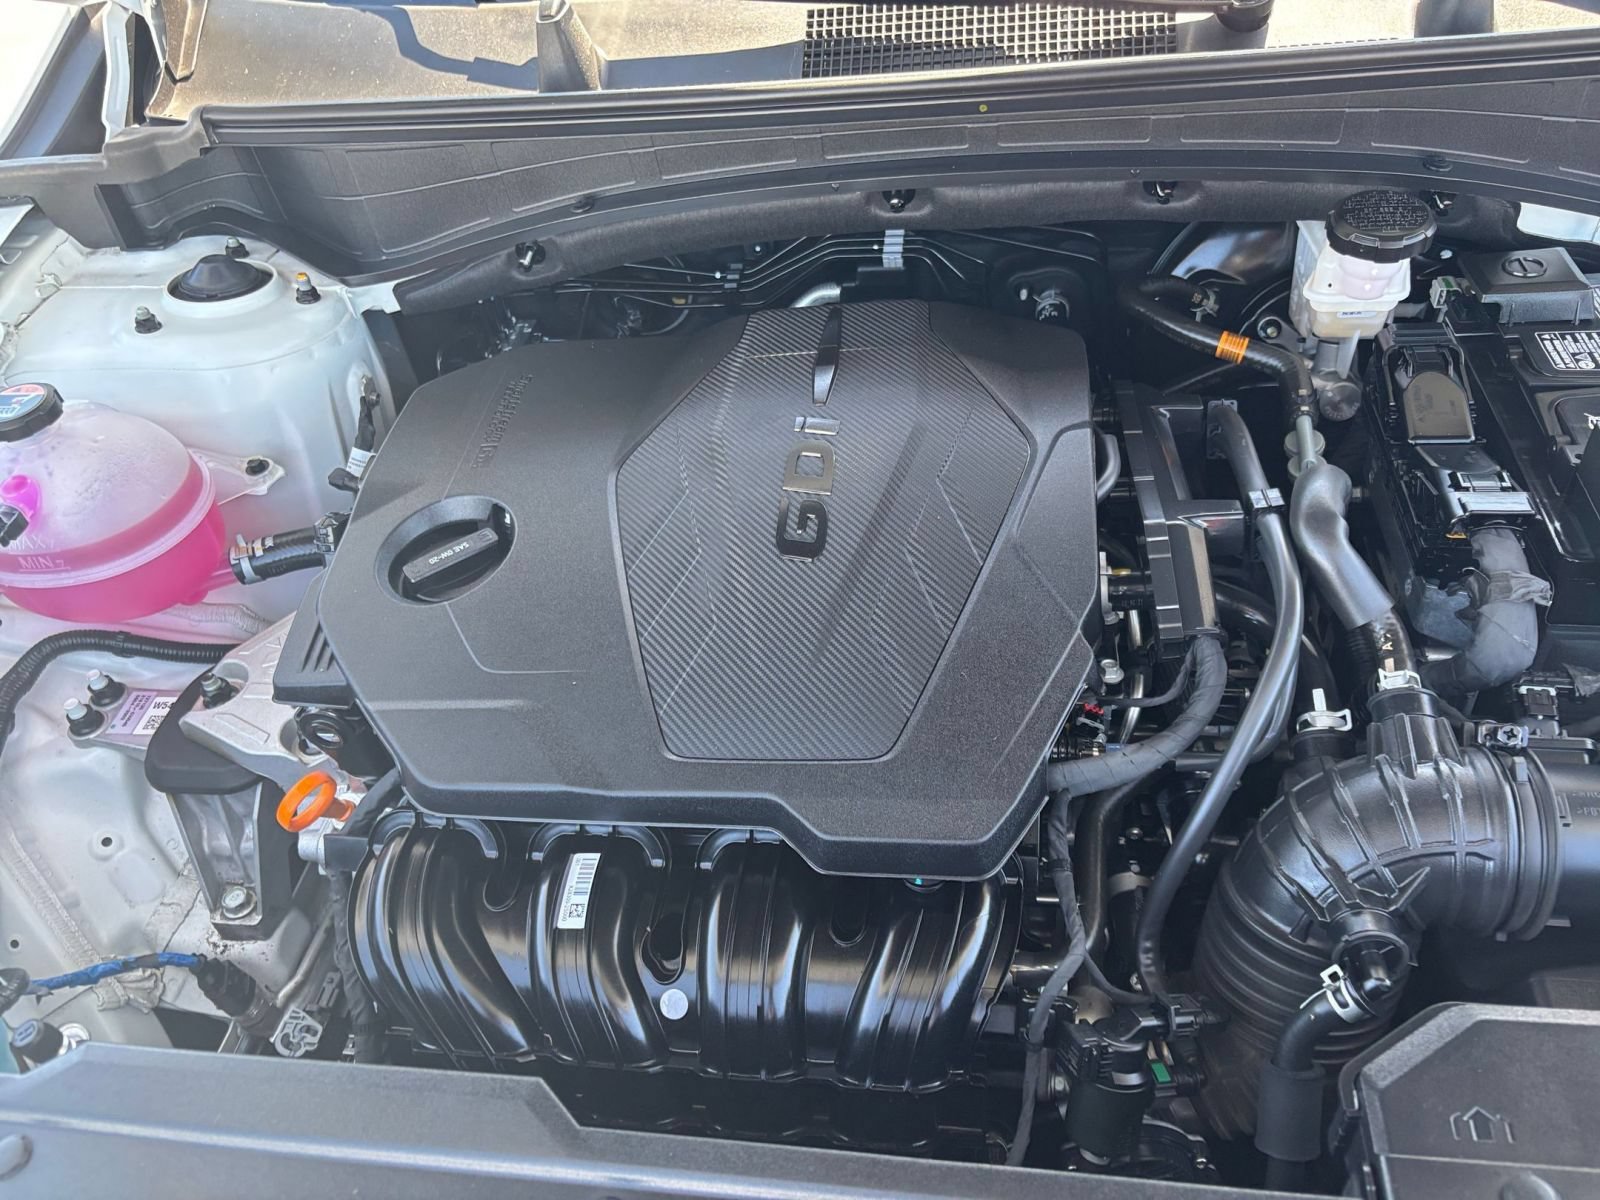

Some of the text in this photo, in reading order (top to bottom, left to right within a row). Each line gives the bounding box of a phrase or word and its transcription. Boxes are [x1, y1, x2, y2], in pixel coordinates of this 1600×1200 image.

[776, 416, 841, 563] GDi
[17, 556, 55, 570] MIN
[428, 541, 470, 565] SAE 0W-20
